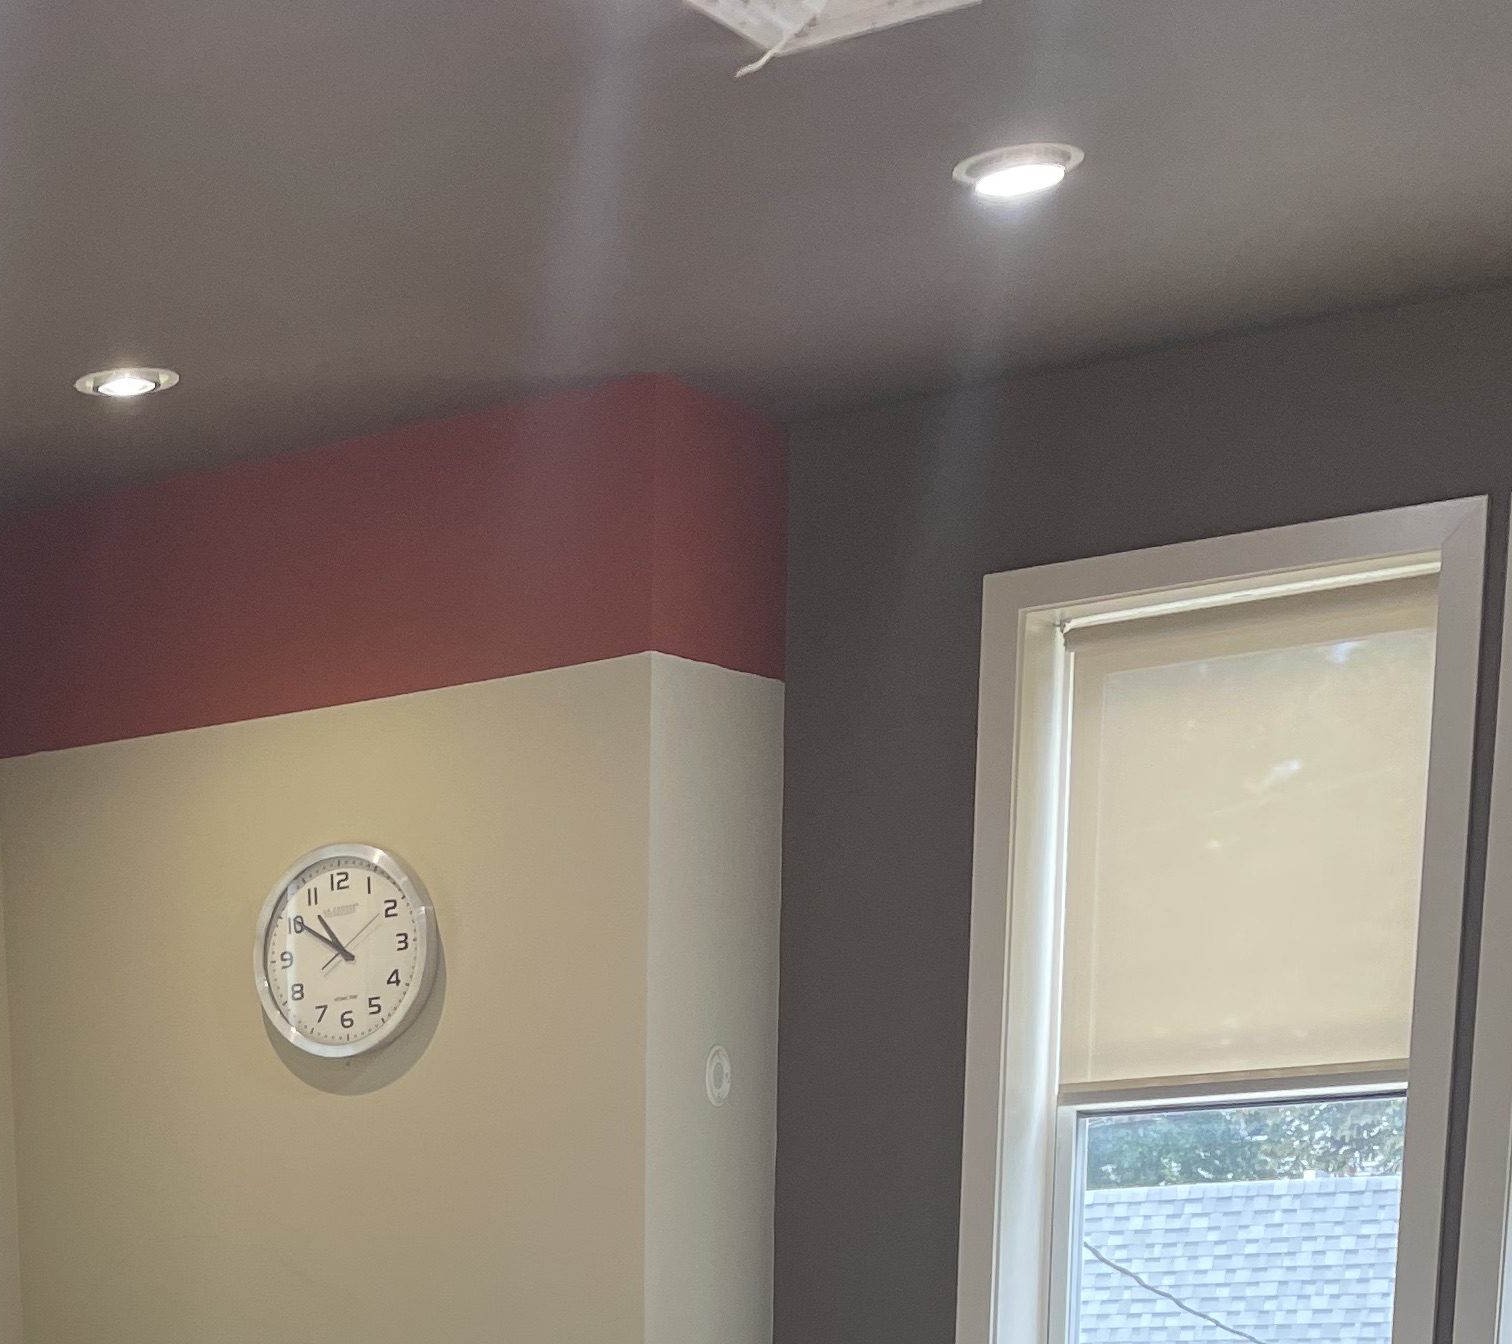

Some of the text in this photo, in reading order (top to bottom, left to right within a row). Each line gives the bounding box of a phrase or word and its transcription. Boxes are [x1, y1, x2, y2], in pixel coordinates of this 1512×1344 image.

[329, 871, 350, 891] 12
[366, 876, 372, 894] 1
[307, 887, 318, 906] 11
[383, 899, 399, 918] 2
[288, 915, 305, 934] 10
[395, 932, 409, 951] 3
[279, 951, 294, 969] 9
[386, 968, 402, 987] 4
[290, 983, 305, 1001] 8
[314, 1004, 329, 1023] 7
[367, 996, 382, 1015] 5
[340, 1010, 355, 1029] 6
